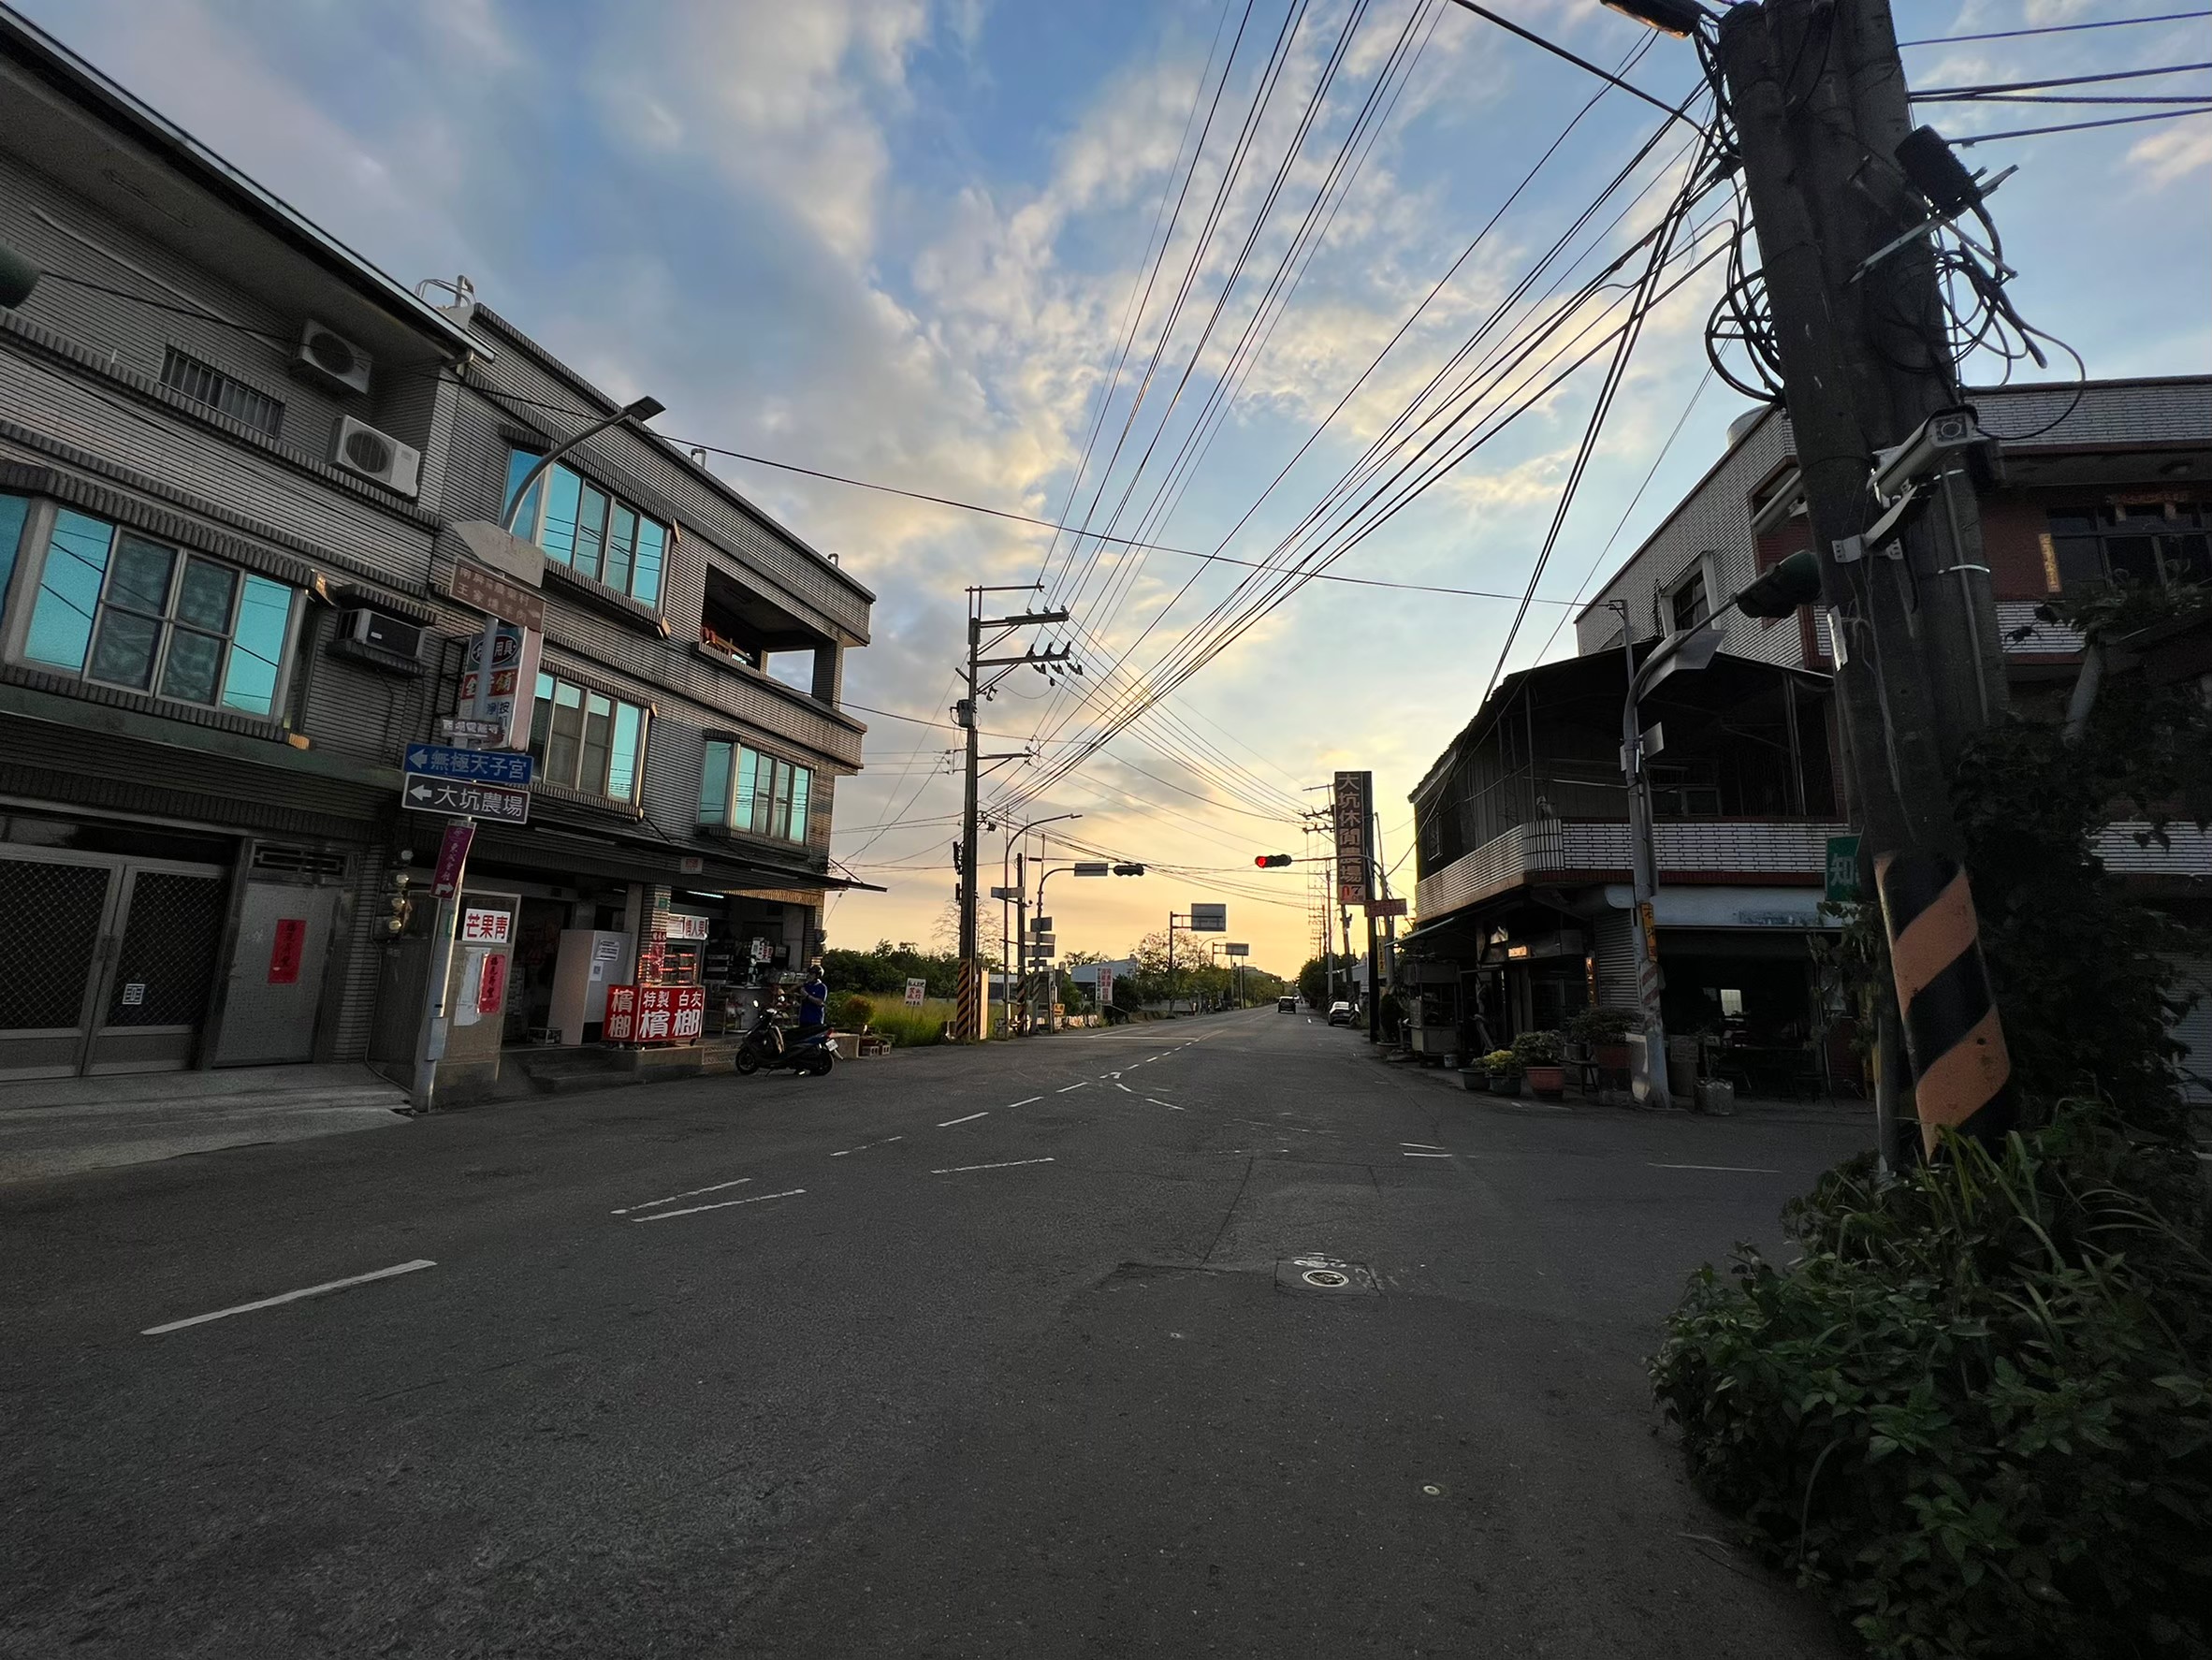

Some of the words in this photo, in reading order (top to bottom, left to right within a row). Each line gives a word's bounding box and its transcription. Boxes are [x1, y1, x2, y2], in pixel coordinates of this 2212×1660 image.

[430, 750, 528, 780] 無極天子宮
[434, 785, 523, 817] 大坑農場
[1338, 773, 1361, 882] 大坑休閒農場
[466, 913, 508, 939] 芒果青
[686, 919, 705, 938] 情人果
[607, 989, 634, 1039] 檳榔
[642, 990, 670, 1009] 特製
[678, 991, 702, 1008] 白灰
[639, 1009, 701, 1039] 檳榔
